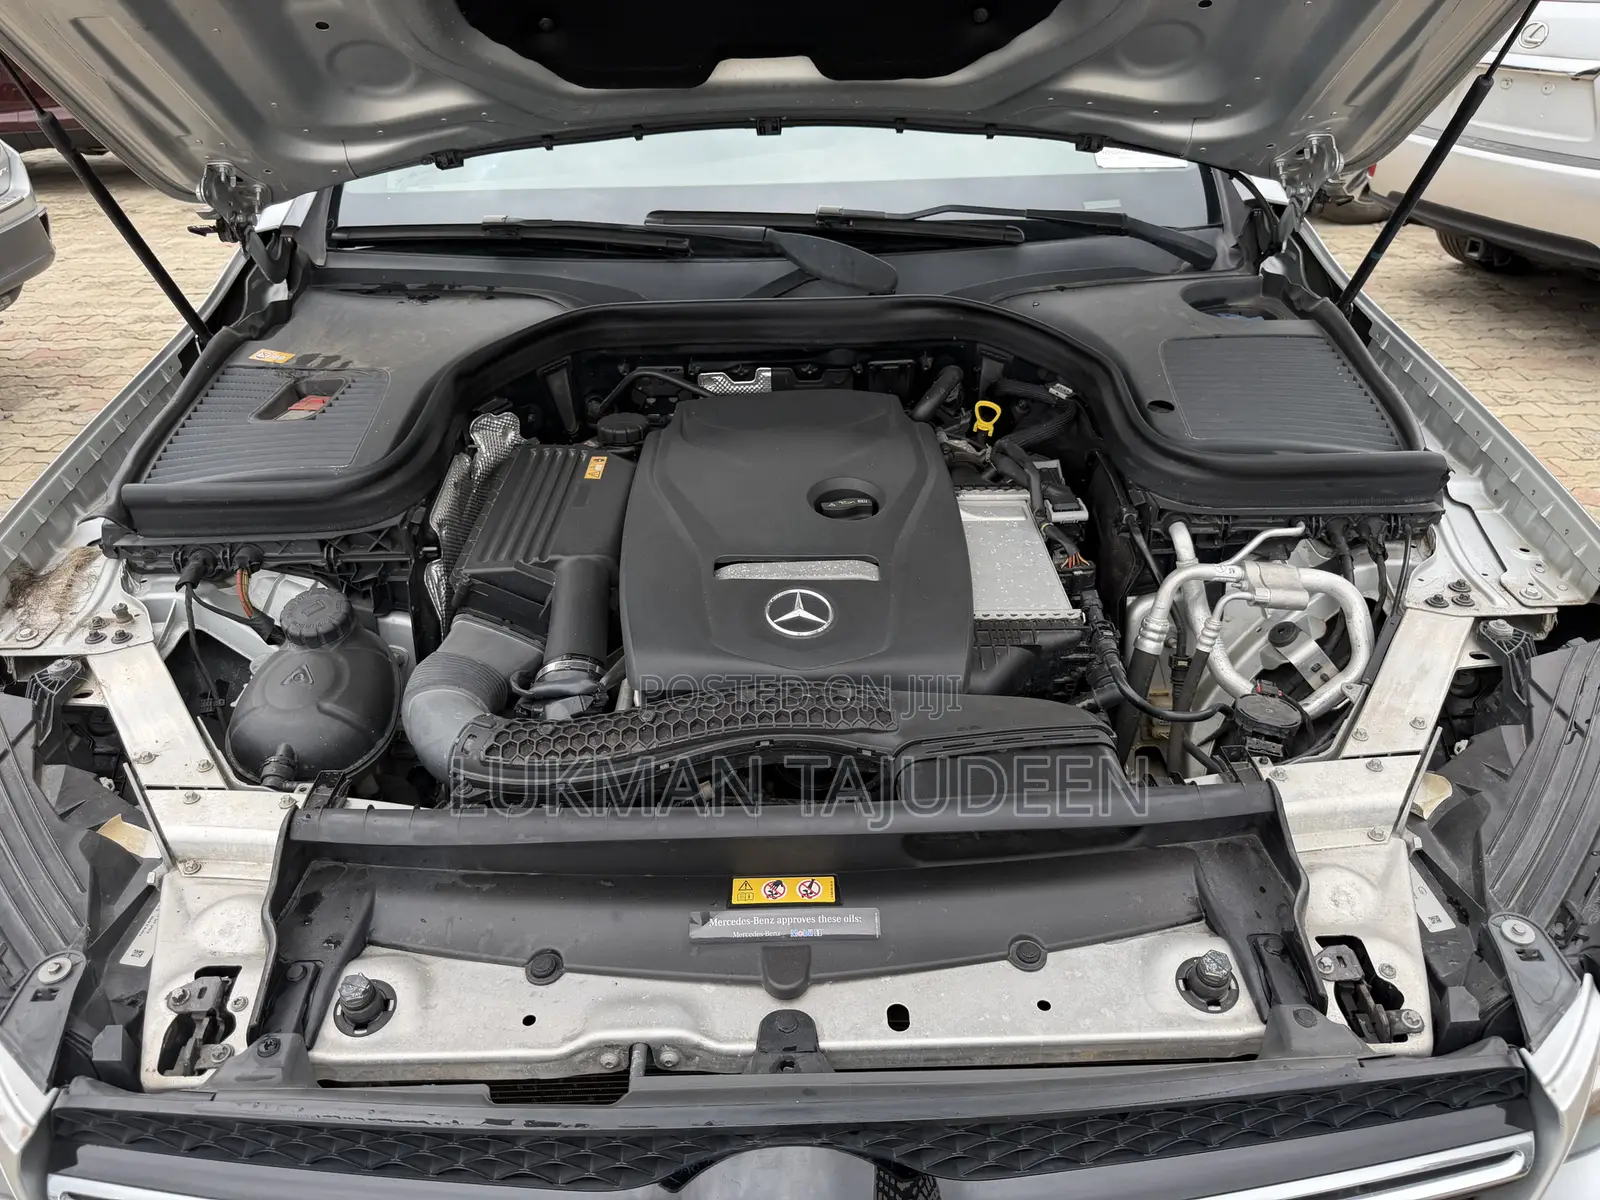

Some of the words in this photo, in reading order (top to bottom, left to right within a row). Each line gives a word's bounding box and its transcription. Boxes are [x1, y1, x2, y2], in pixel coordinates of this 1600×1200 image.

[709, 916, 775, 927] Mercedes-Benz
[777, 915, 816, 926] approves
[818, 914, 842, 924] these
[843, 913, 862, 923] oils:
